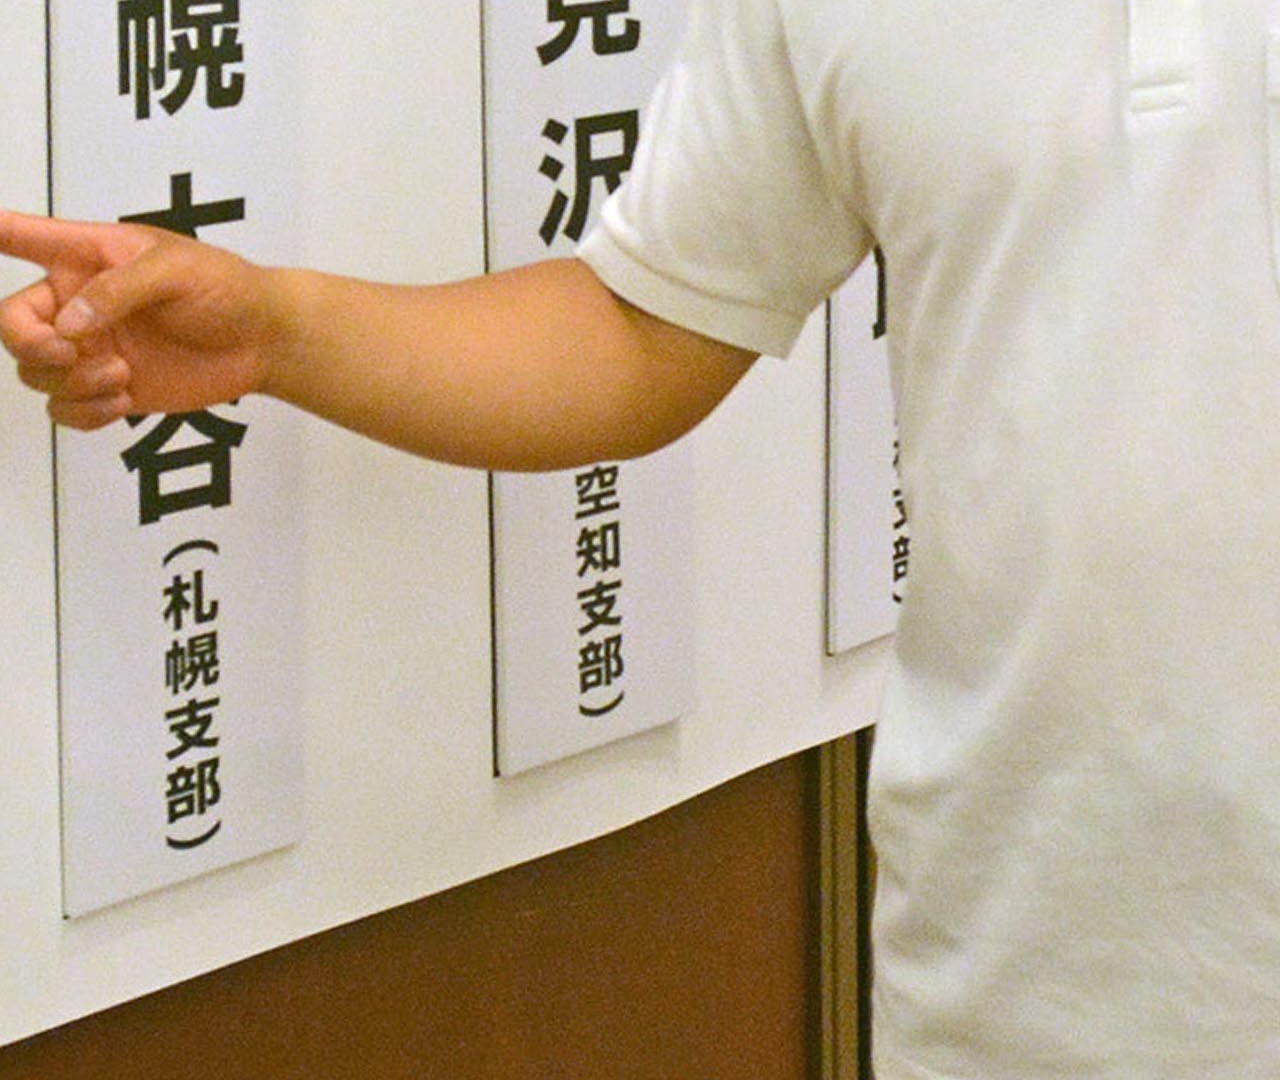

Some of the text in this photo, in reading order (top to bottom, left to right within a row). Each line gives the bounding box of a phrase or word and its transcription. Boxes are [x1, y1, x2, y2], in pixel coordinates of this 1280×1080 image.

[161, 538, 223, 851] (札幌支部)
[574, 464, 625, 719] 空知支部)
